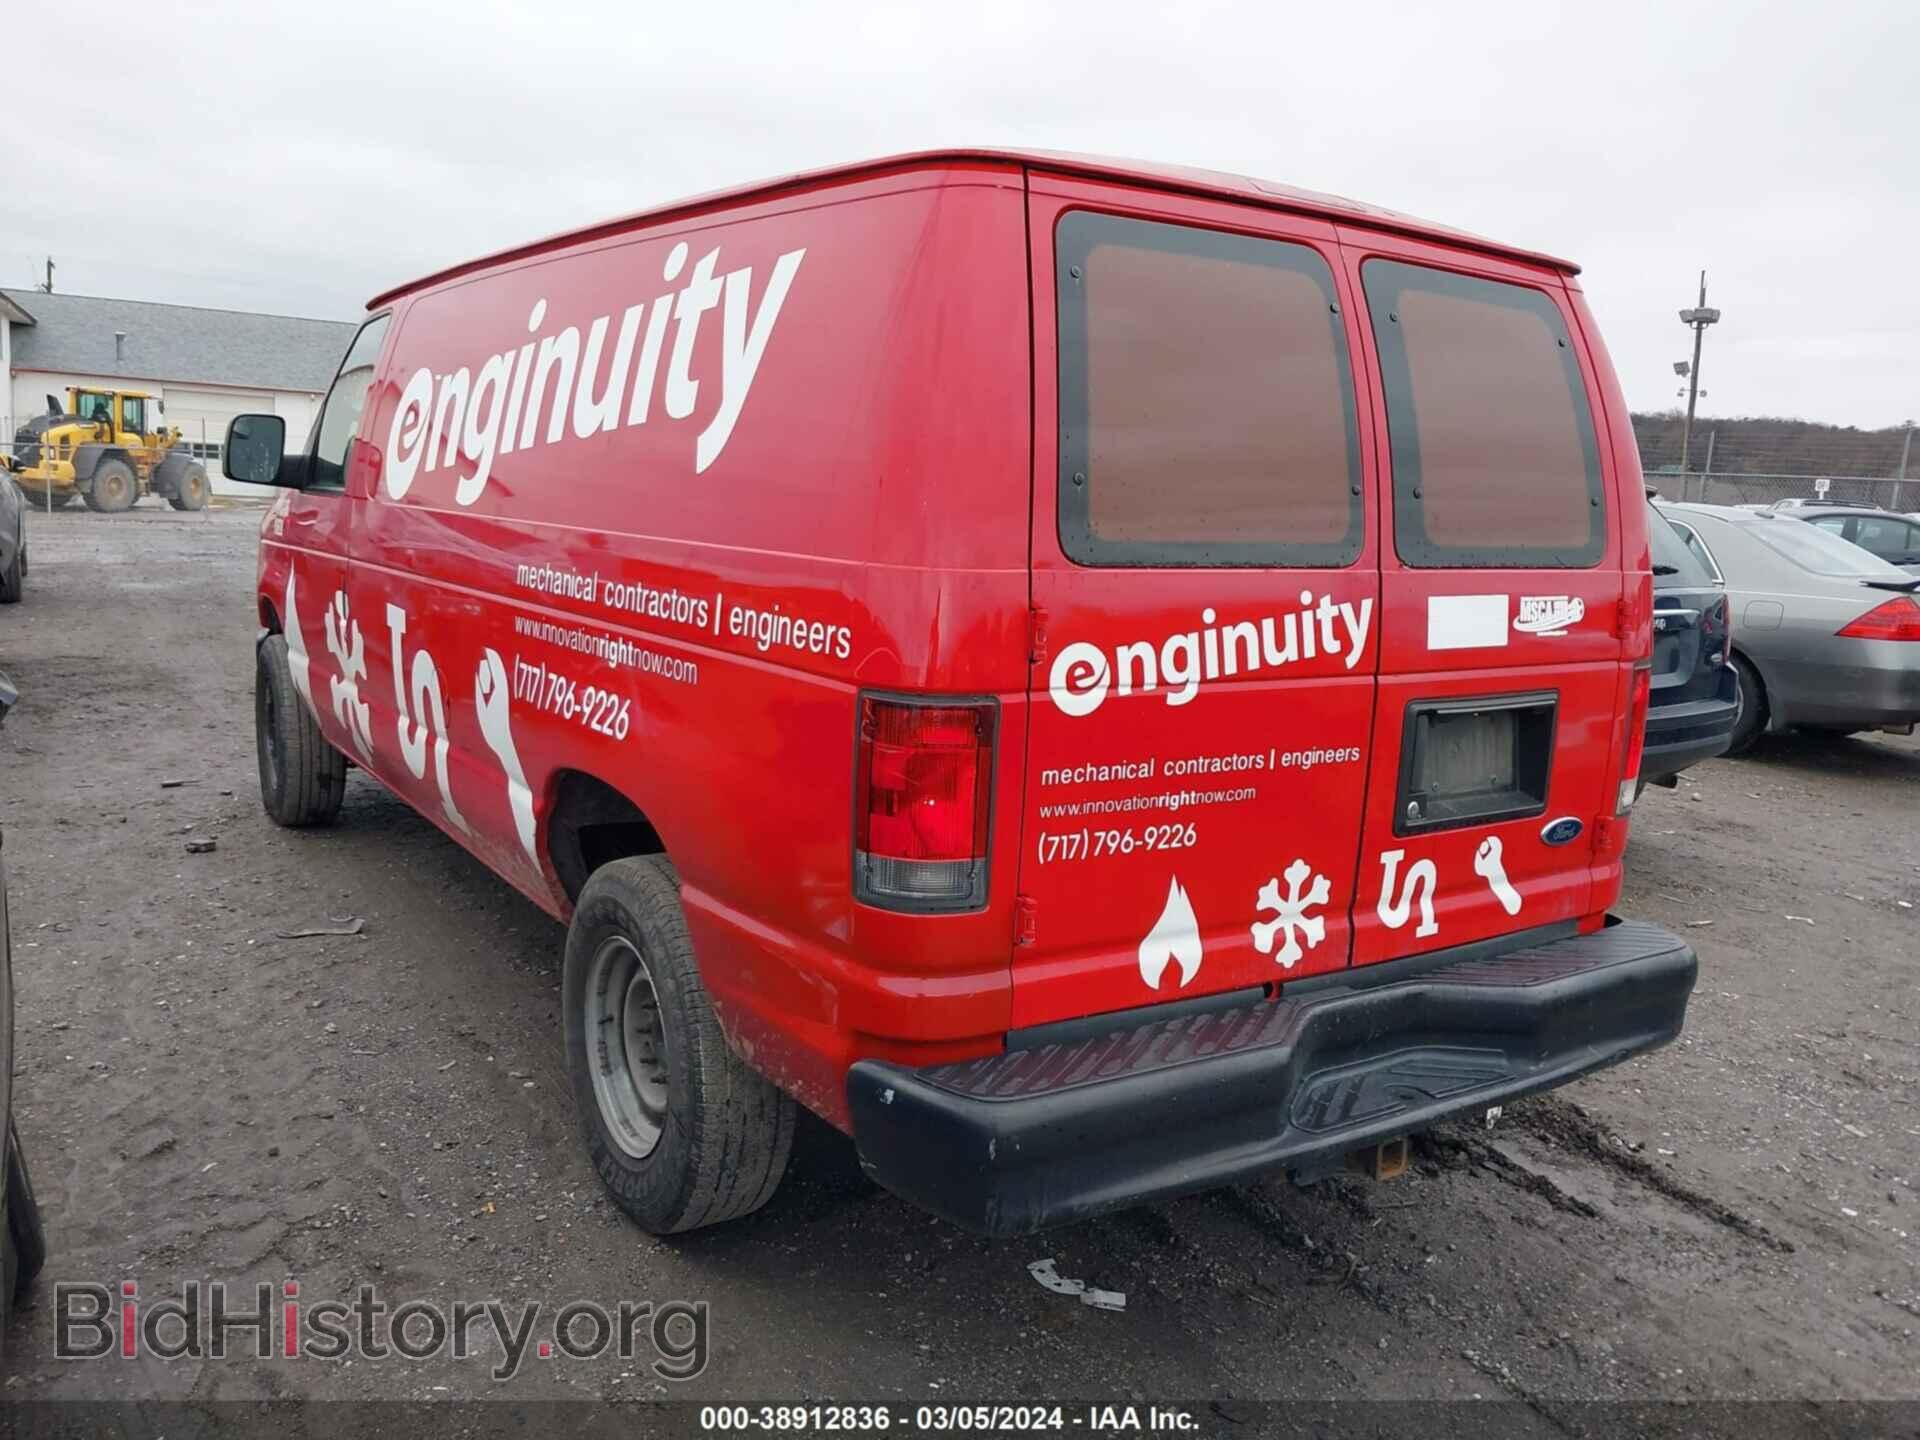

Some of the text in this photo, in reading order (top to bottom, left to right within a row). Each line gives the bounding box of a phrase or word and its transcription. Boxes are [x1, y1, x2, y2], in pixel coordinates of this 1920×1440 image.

[386, 241, 807, 506] enginuity
[514, 614, 698, 686] www.innovationrightnow.com
[516, 561, 599, 603] mechanical
[604, 581, 709, 629] contractors
[729, 604, 852, 660] engineers
[1049, 590, 1374, 717] enginuity
[513, 653, 632, 741] (717) 796-9226
[1039, 786, 1257, 819] www.innovationrightnow.com
[1041, 758, 1155, 786] mechanical
[1163, 750, 1265, 777] contractors
[1280, 745, 1361, 769] engineers
[1037, 822, 1198, 865] (717) 796-9226
